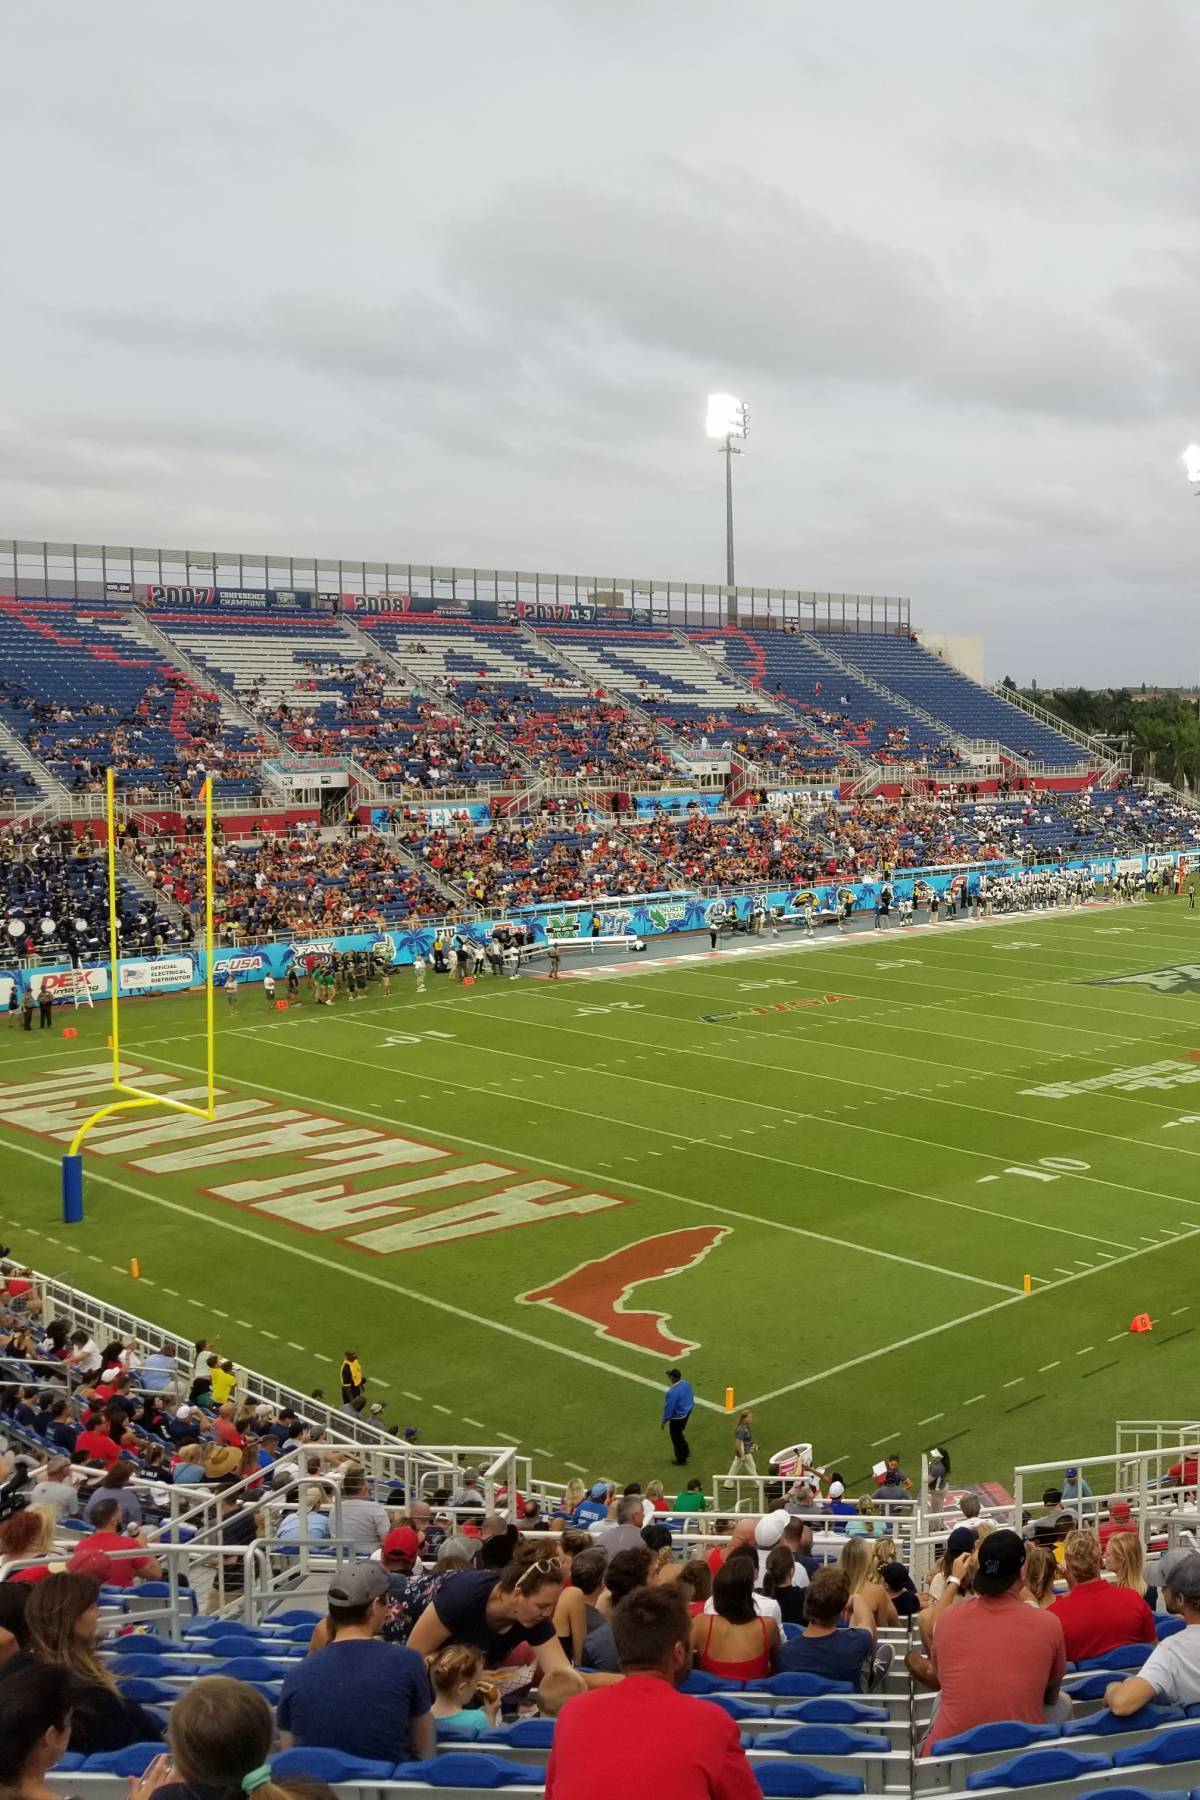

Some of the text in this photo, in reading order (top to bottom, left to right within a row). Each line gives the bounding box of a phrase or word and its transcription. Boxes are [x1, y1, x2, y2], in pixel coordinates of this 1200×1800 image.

[151, 586, 209, 605] 2007
[219, 591, 266, 600] CONFERENCE
[219, 599, 266, 607] CHAMPIONS
[354, 595, 405, 612] 2008
[524, 604, 567, 620] 2017
[570, 609, 591, 620] 11-3
[1091, 863, 1111, 876] Field
[660, 905, 684, 913] NORTH
[664, 911, 684, 919] TEXAS
[547, 915, 578, 938] M
[602, 914, 630, 934] MT
[436, 928, 455, 938] FIU
[295, 943, 331, 954] FAU
[151, 969, 187, 977] ELECTRICAL
[151, 974, 191, 984] DISTRIBUTOR
[1003, 1157, 1092, 1182] 10
